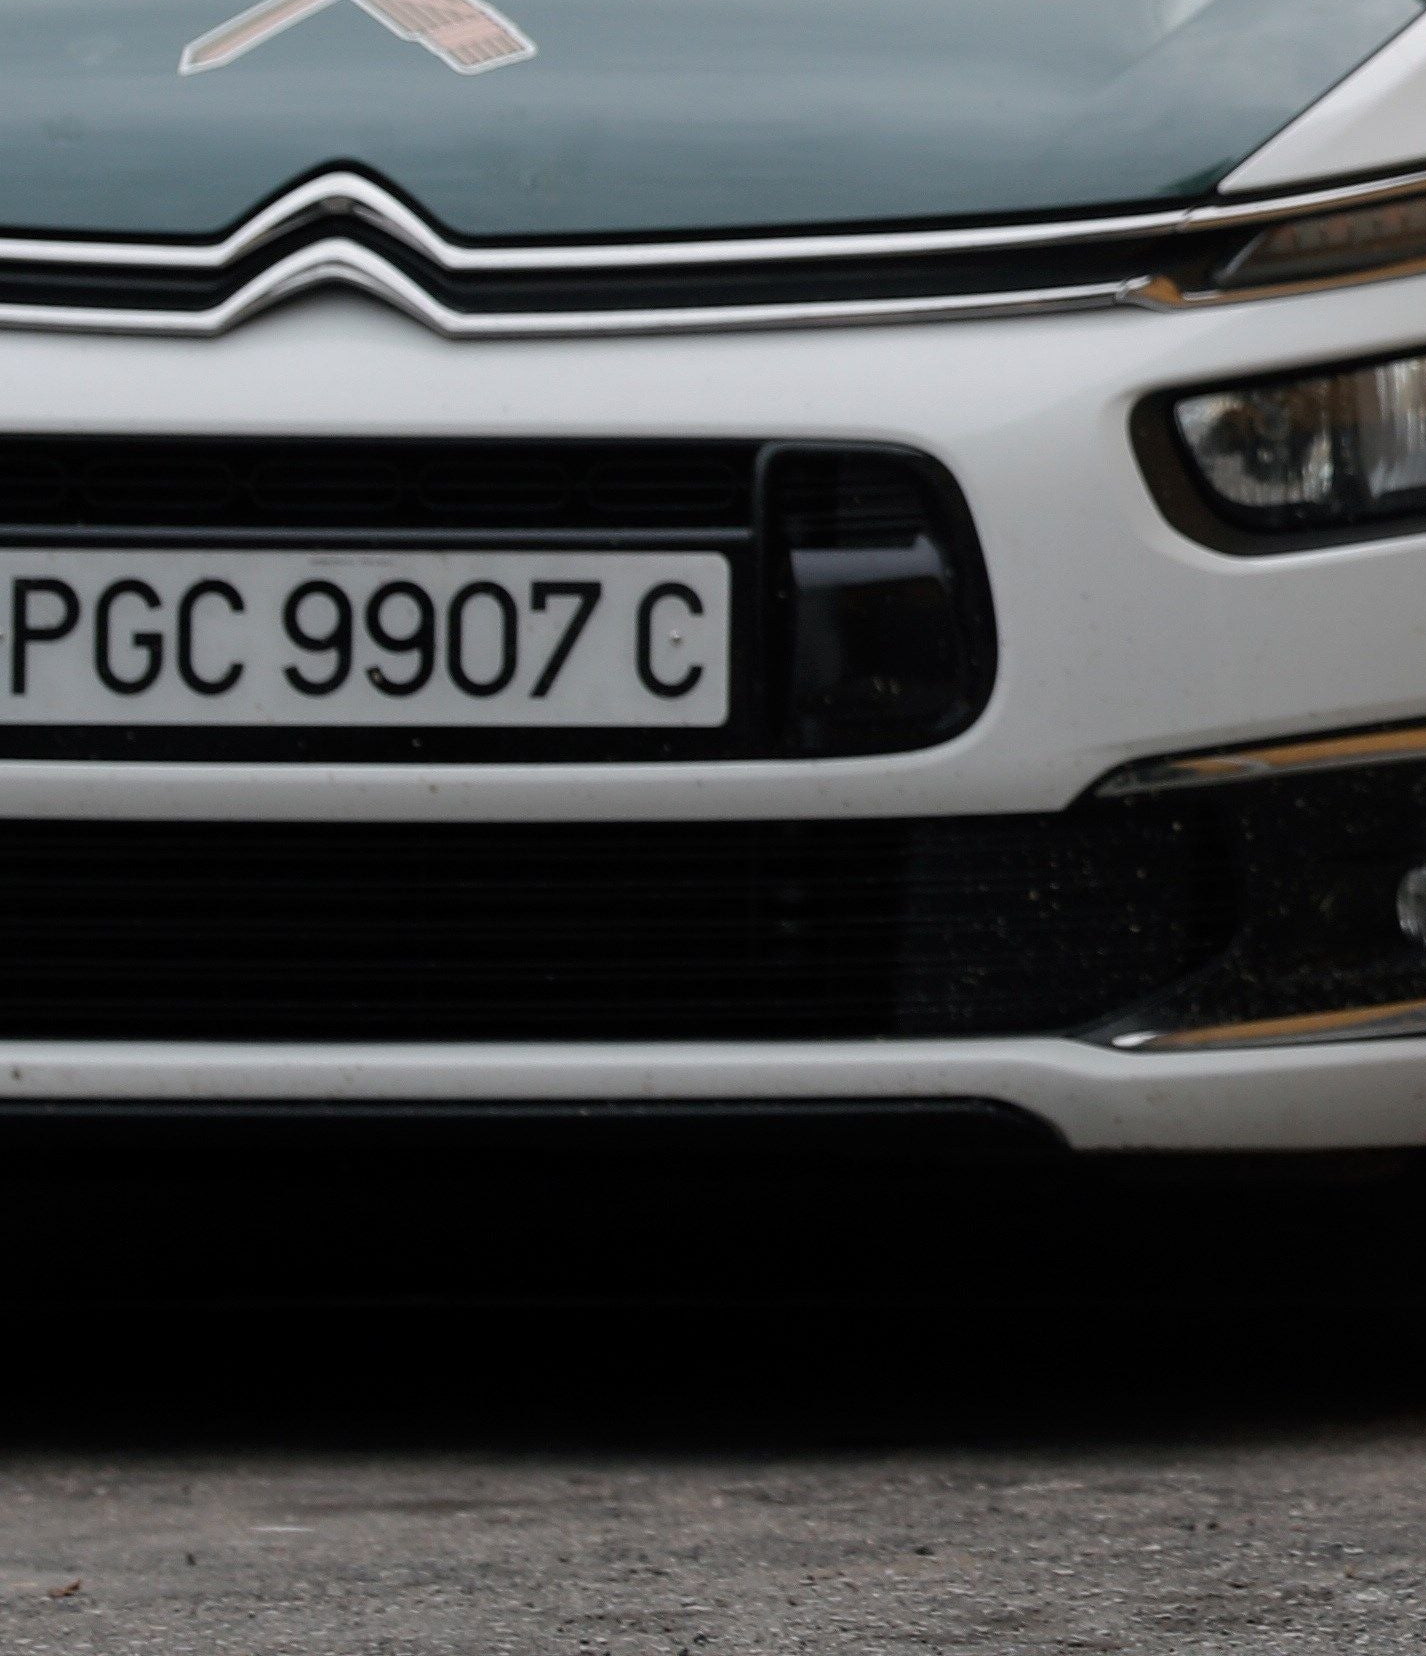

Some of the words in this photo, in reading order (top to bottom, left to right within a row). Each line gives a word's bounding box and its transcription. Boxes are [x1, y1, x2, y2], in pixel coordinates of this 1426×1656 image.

[9, 577, 247, 698] PGC
[281, 579, 604, 700] 9907
[635, 581, 706, 700] C
